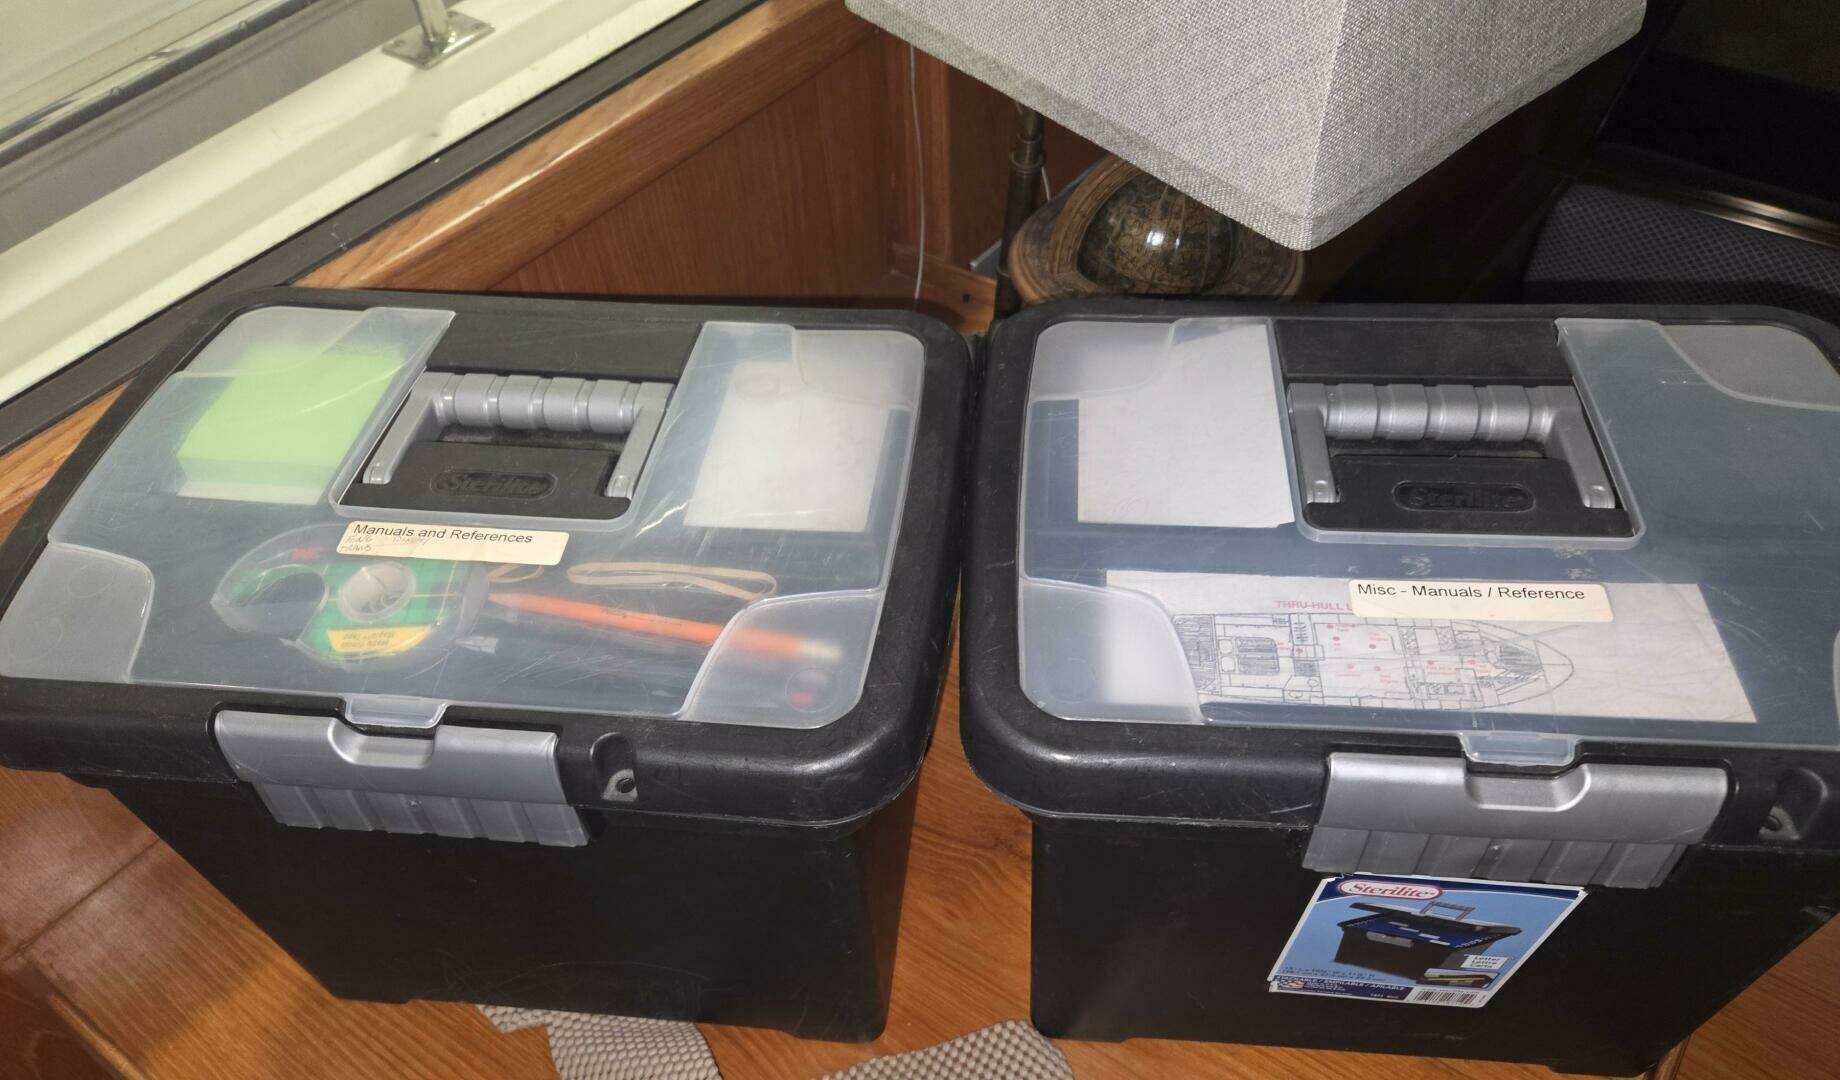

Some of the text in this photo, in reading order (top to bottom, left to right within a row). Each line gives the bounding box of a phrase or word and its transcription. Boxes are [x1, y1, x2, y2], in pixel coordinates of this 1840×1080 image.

[353, 524, 533, 543] Manuals and References
[1358, 583, 1397, 596] Misc
[1412, 585, 1482, 598] Manuals
[1498, 587, 1585, 600] Reference
[1276, 600, 1344, 611] THRU-HULL
[1350, 883, 1423, 898] Sterilite
